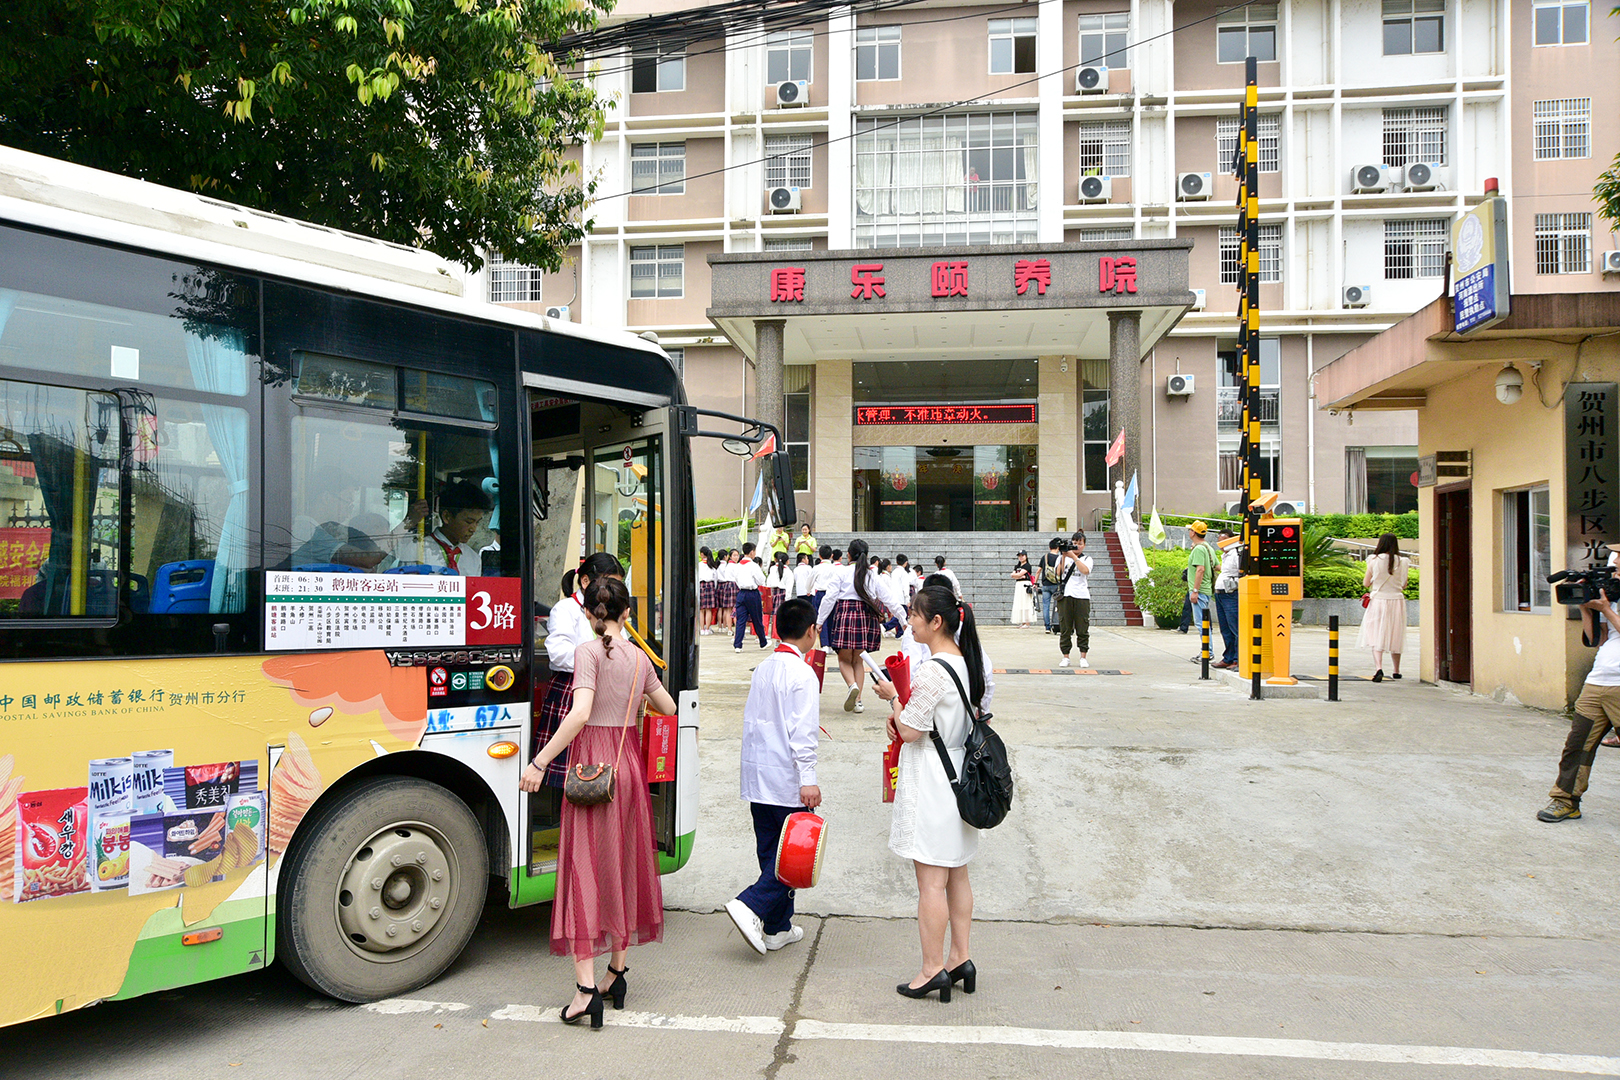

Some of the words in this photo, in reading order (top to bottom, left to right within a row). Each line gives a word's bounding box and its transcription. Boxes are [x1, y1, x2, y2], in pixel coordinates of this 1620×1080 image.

[770, 256, 1138, 302] 康乐颐养院
[1267, 528, 1275, 537] P
[332, 577, 399, 593] 鹅塘客运站
[437, 580, 460, 593] 黄田
[0, 689, 165, 713] 中国邮政储蓄银行
[169, 689, 246, 707] 贺州市分行
[0, 713, 38, 722] POSTAL
[42, 709, 88, 720] SAVINGS
[91, 706, 118, 716] BANK
[121, 706, 133, 715] OF
[136, 705, 165, 714] CHINA
[90, 773, 132, 802] Milkis
[132, 767, 167, 793] Milk
[57, 806, 76, 860] 새우깡
[102, 834, 130, 854] 봉봉
